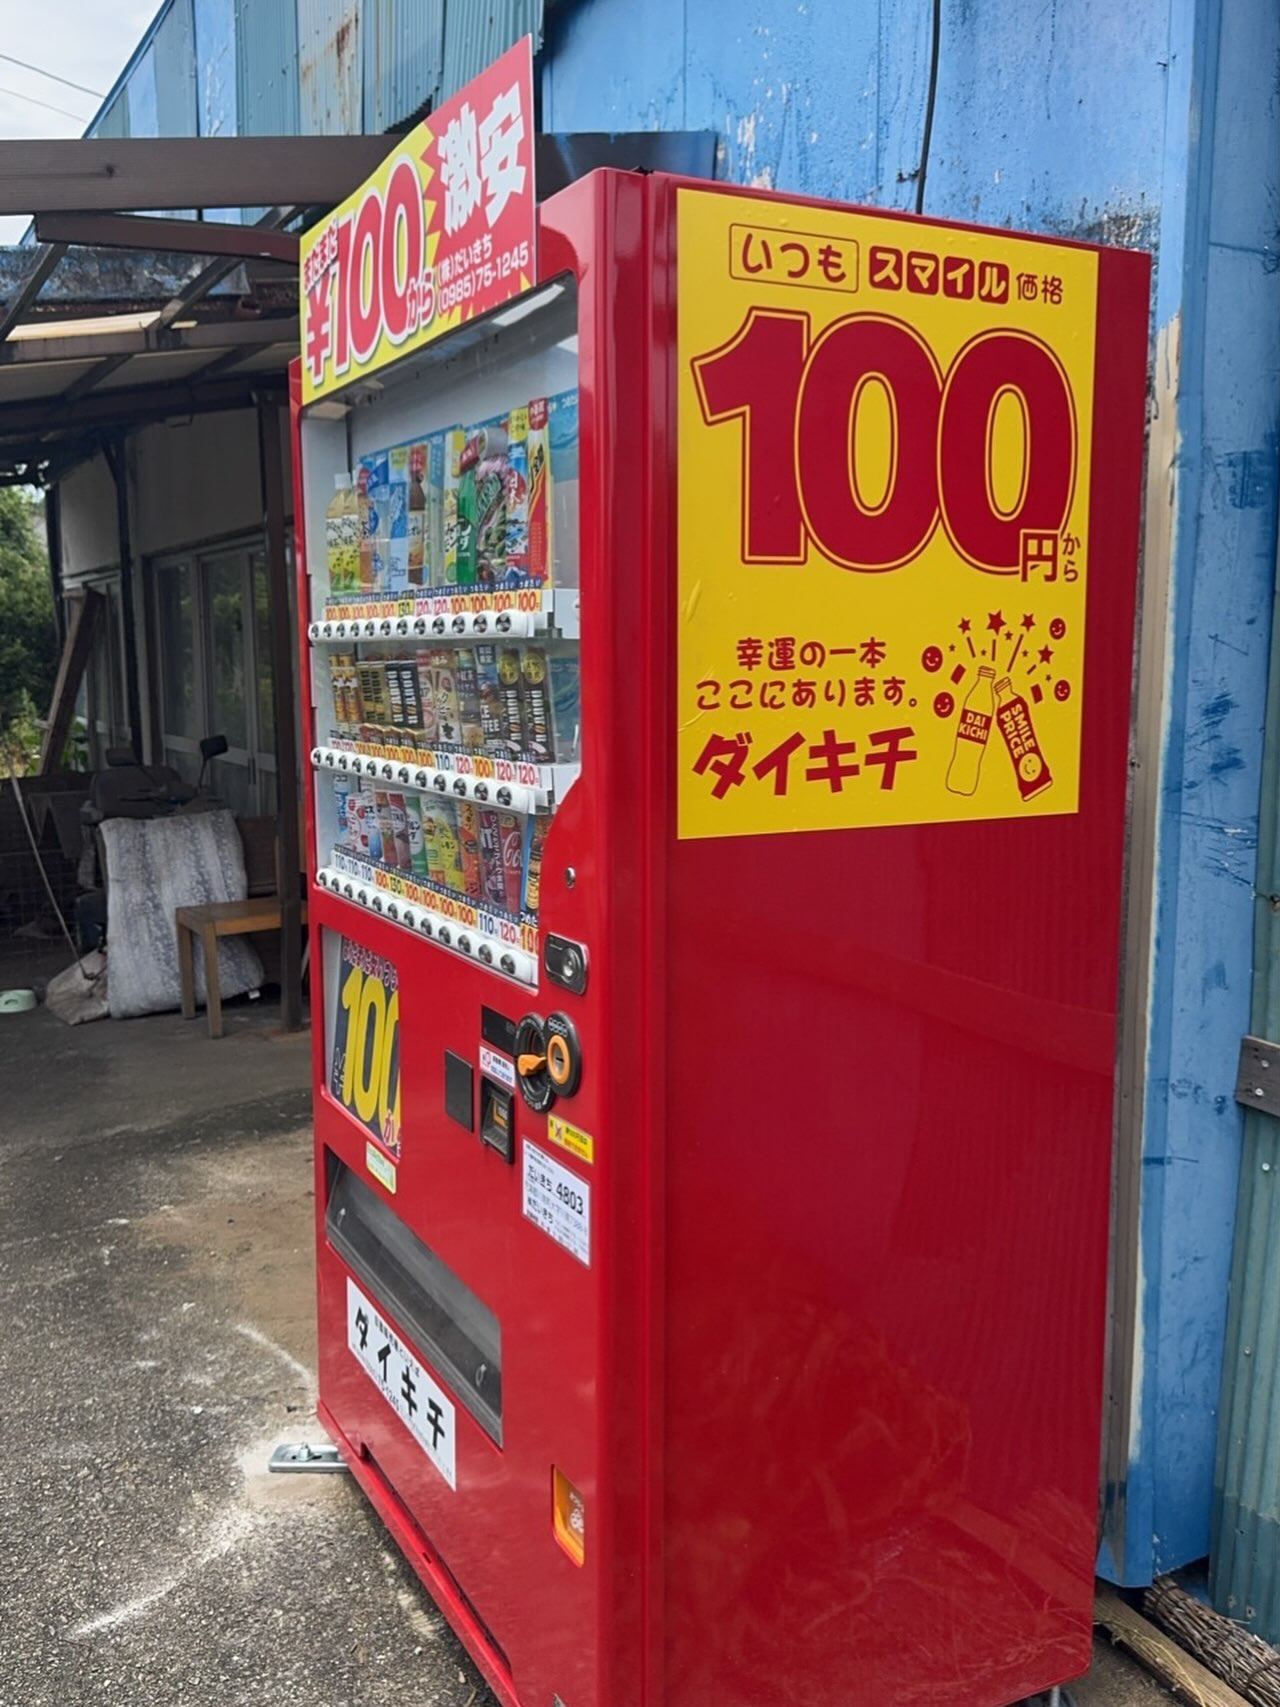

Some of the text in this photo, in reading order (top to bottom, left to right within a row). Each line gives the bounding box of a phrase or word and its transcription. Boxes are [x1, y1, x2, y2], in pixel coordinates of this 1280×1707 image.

[438, 82, 526, 238] 激安
[741, 232, 1064, 305] いつも スマイル 価格
[736, 636, 887, 672] 幸運の一本
[696, 678, 918, 710] ここにあります。
[958, 722, 988, 741] KICHI
[965, 712, 986, 728] DAI
[1000, 710, 1026, 759] PRICE
[1011, 703, 1036, 752] SMILE
[691, 726, 918, 801] ダイキチ
[556, 1181, 584, 1216] 4803
[355, 1306, 446, 1451] ダイキチ
